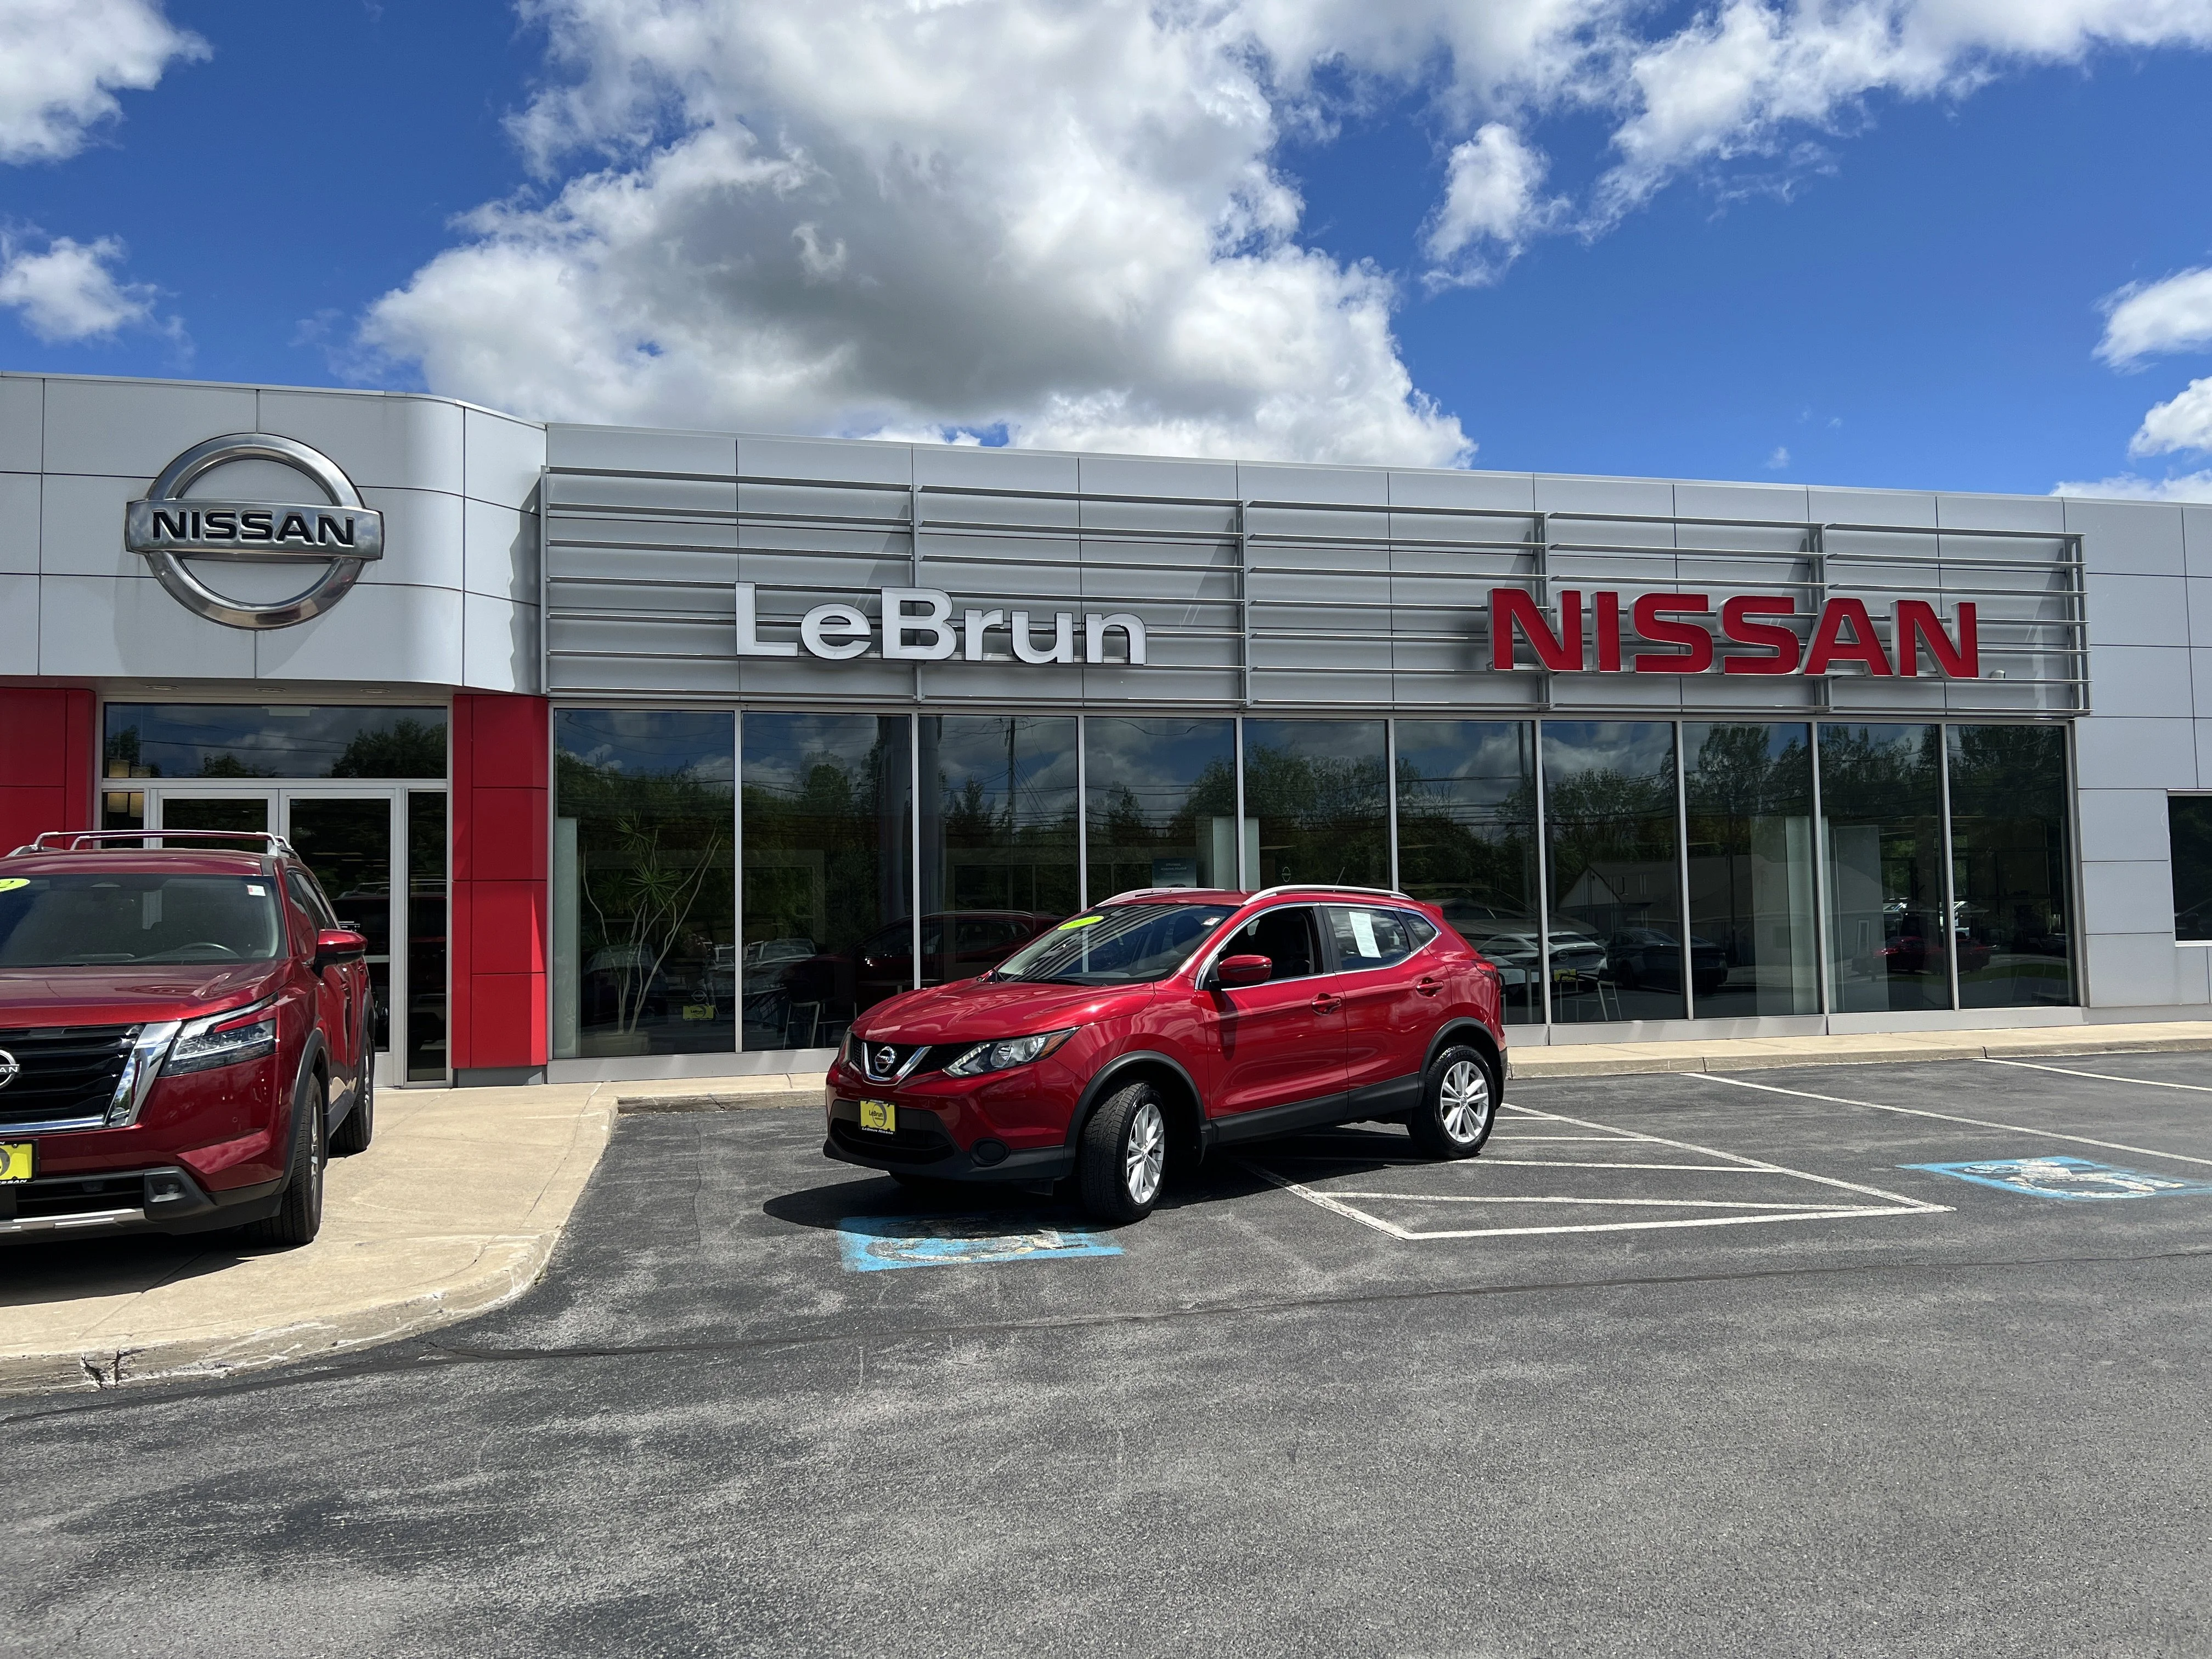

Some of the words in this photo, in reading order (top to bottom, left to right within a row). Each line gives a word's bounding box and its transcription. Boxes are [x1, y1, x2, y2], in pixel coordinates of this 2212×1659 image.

[152, 510, 356, 547] NISSAN
[735, 581, 1147, 664] LeBrun
[1487, 588, 1979, 679] NISSAN
